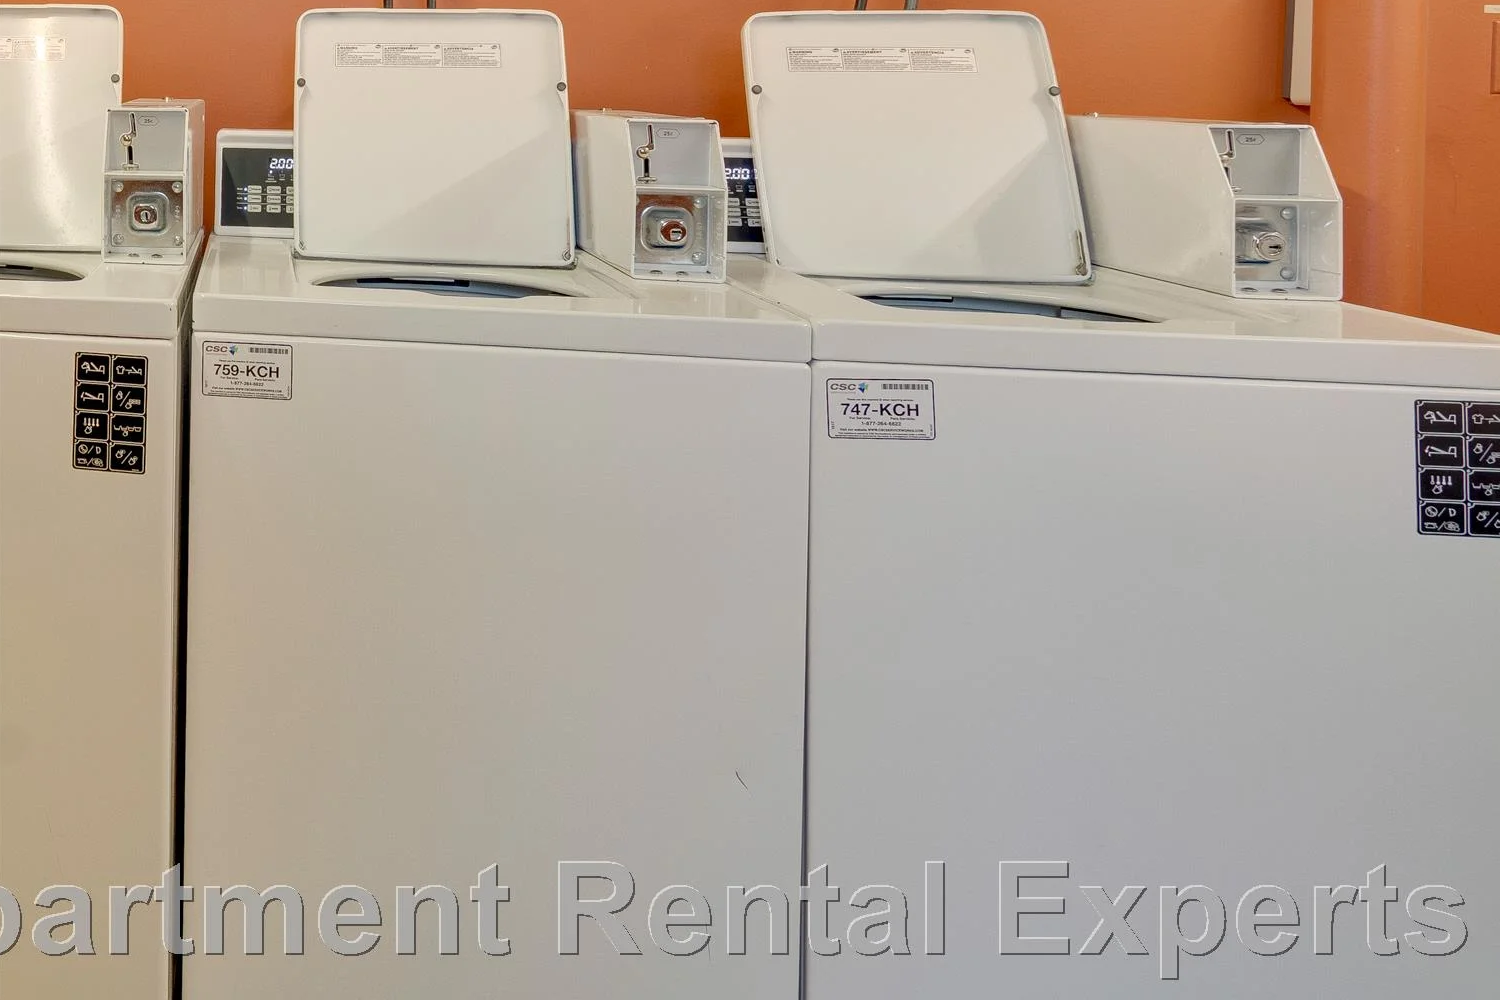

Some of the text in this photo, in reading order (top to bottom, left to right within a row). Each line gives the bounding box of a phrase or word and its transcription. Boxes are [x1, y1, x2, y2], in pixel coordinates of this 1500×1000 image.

[214, 363, 279, 378] 759-KCH
[830, 383, 857, 391] CSC
[840, 403, 919, 417] 747-KCH
